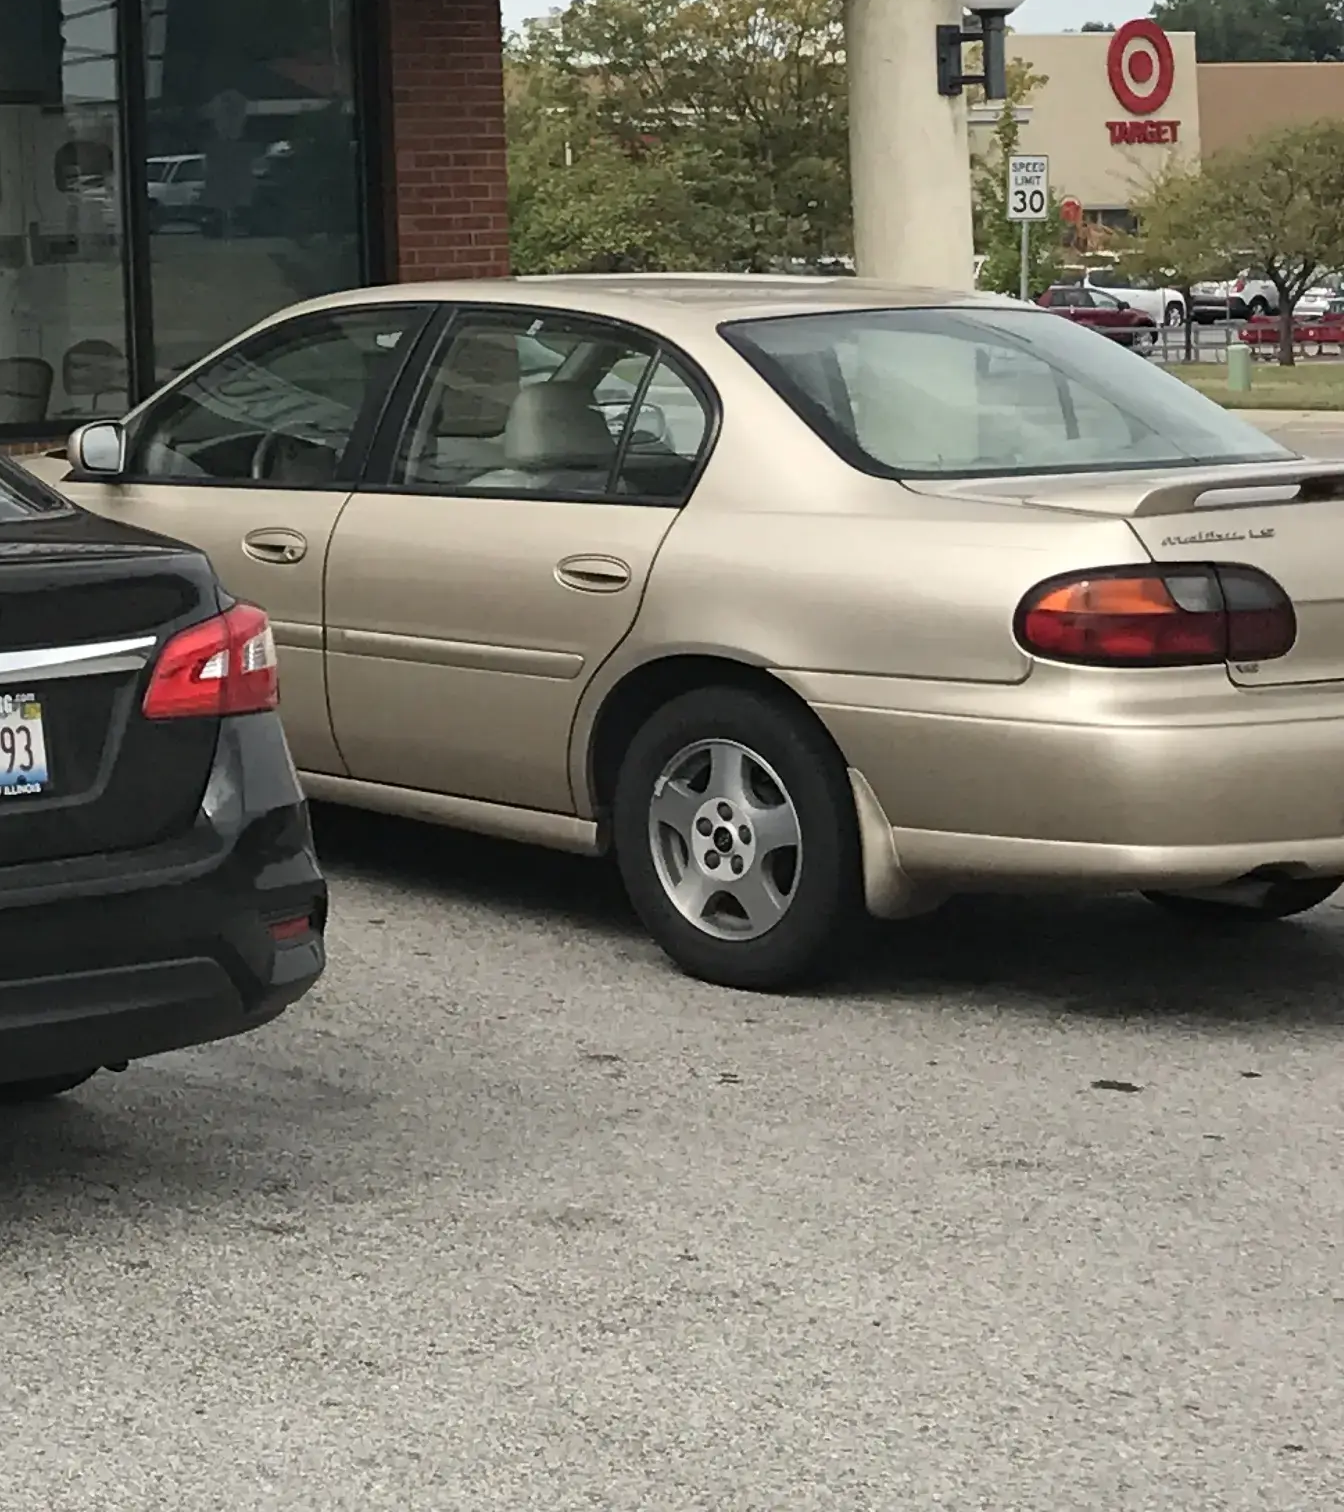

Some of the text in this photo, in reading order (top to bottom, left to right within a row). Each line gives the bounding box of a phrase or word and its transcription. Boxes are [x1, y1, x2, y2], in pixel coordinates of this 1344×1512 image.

[1106, 120, 1181, 145] TARGET
[1012, 162, 1045, 172] SPEED
[1015, 175, 1041, 186] LIMIT
[1012, 190, 1044, 213] 30
[0, 725, 34, 774] 93
[4, 783, 42, 796] ILLINOIS
